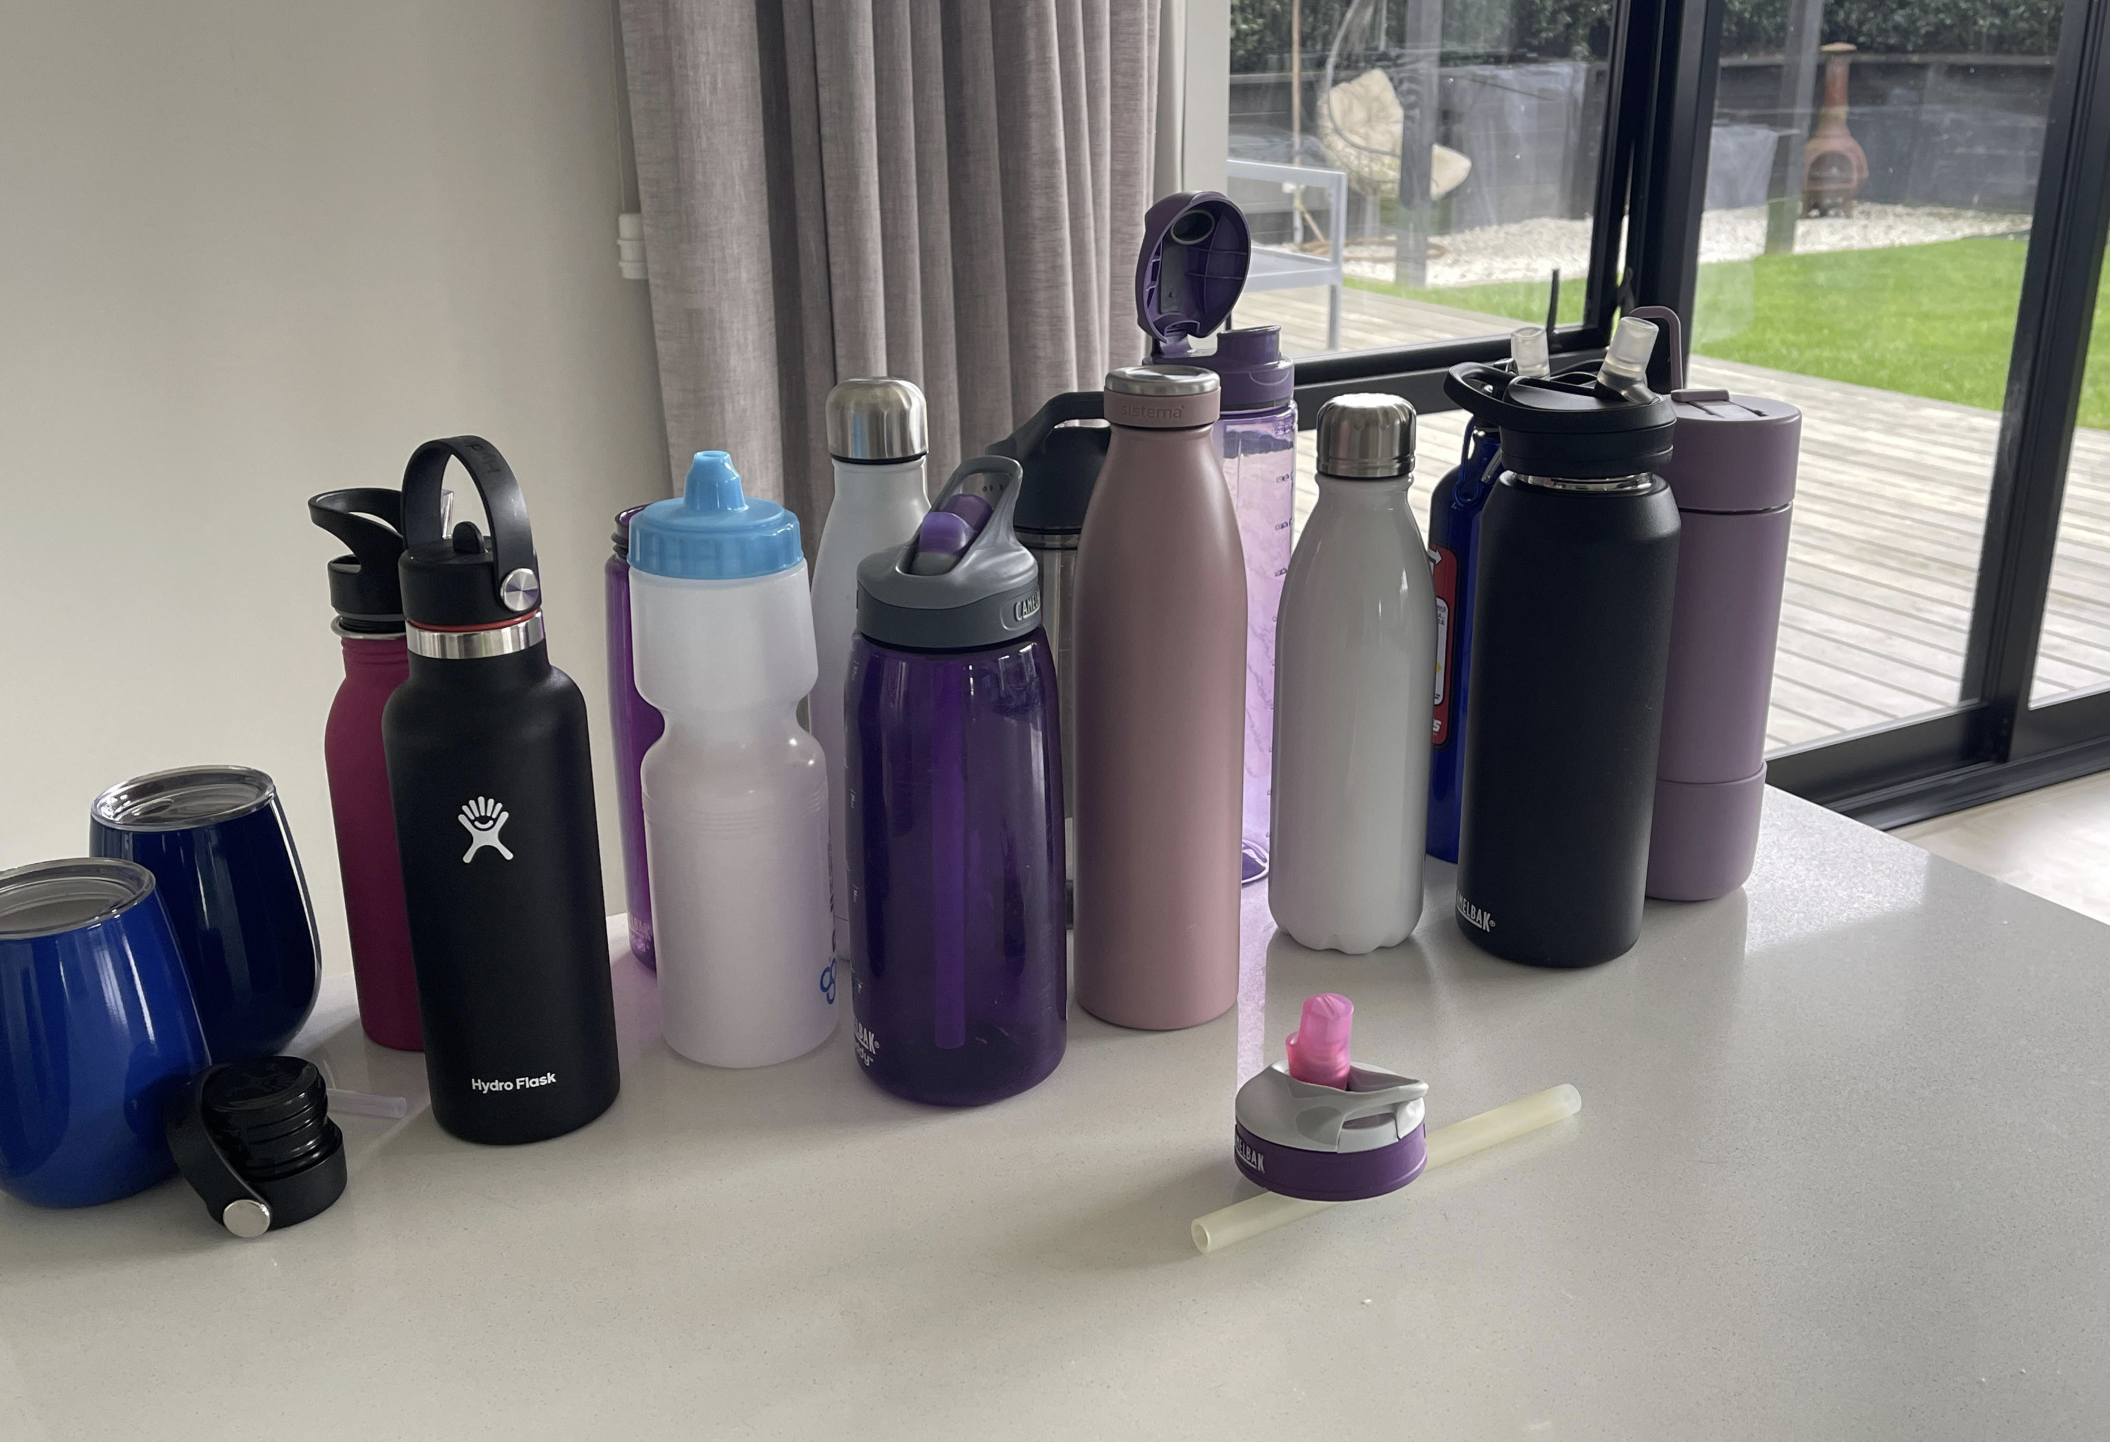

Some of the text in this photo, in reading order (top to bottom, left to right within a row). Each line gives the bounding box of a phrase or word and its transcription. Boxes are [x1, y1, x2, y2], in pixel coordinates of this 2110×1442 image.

[1120, 404, 1183, 420] sistema
[471, 1071, 557, 1095] Hydro Flask
